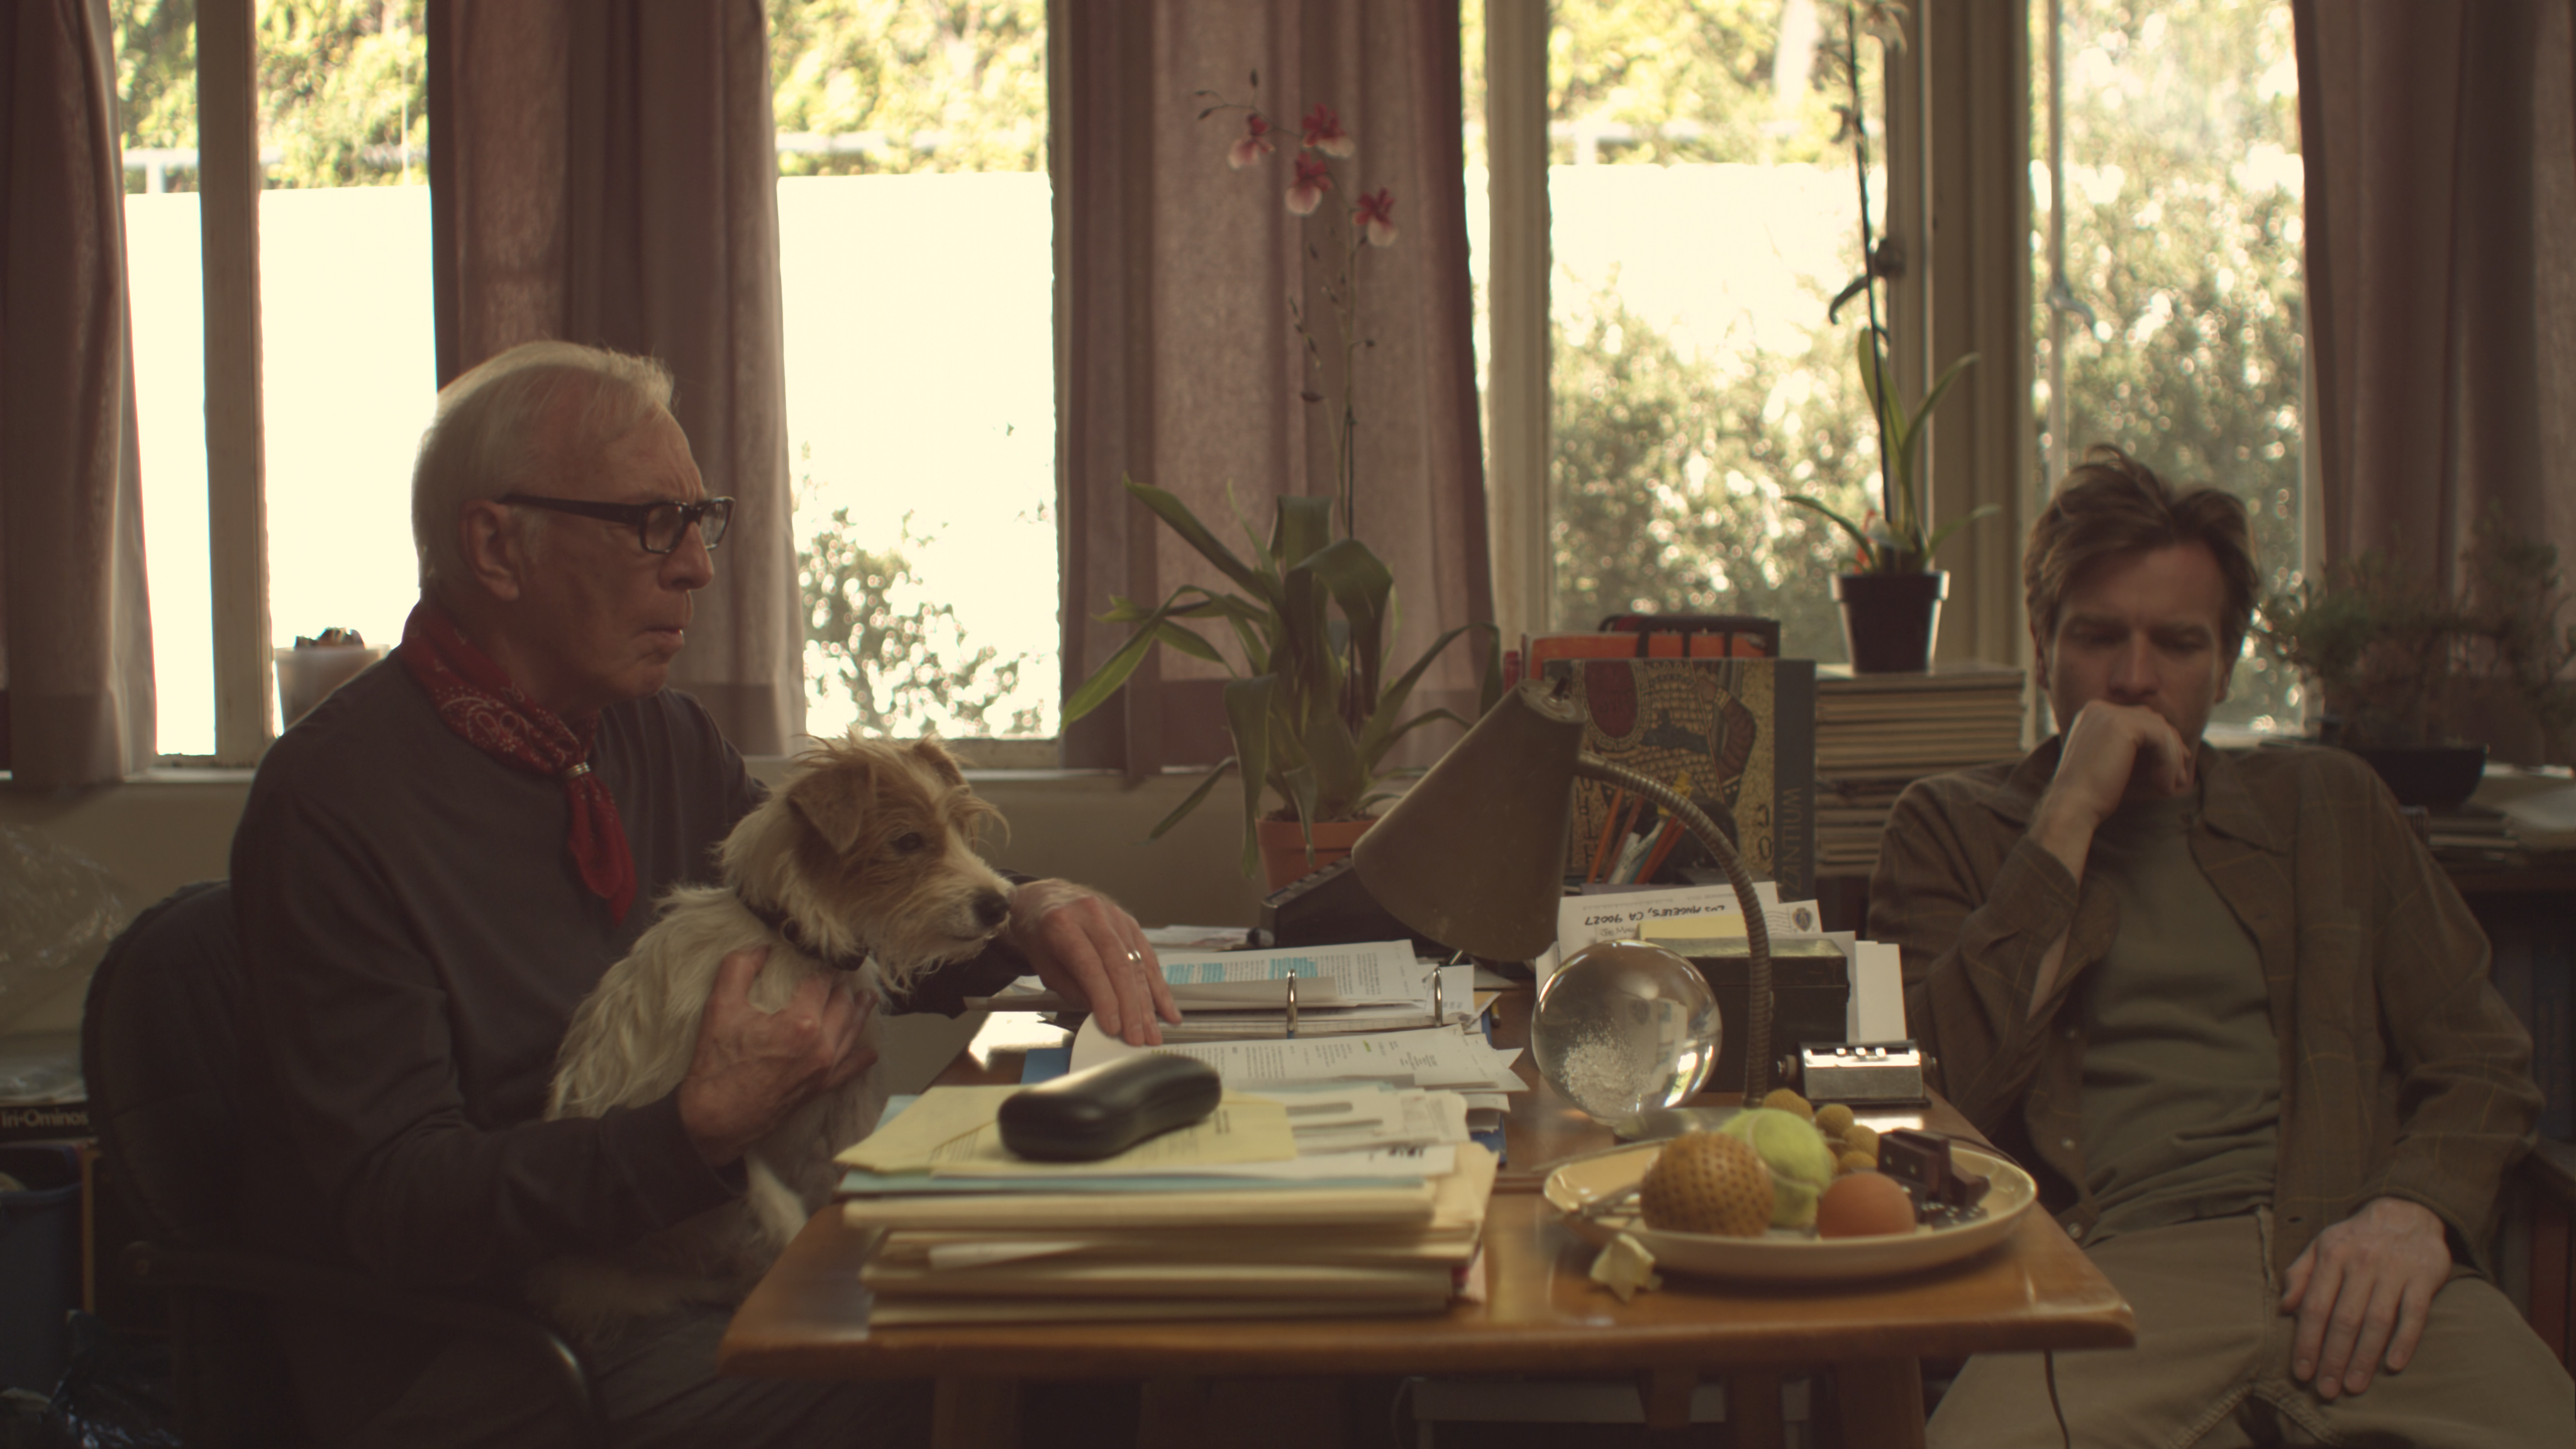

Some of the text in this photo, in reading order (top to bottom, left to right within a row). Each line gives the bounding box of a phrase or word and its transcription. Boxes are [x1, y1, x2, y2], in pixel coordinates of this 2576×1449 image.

[1781, 787, 1802, 901] YZANTIUM
[1629, 911, 1644, 921] CA
[1647, 905, 1701, 918] ANGELES,
[1584, 914, 1623, 926] 90027
